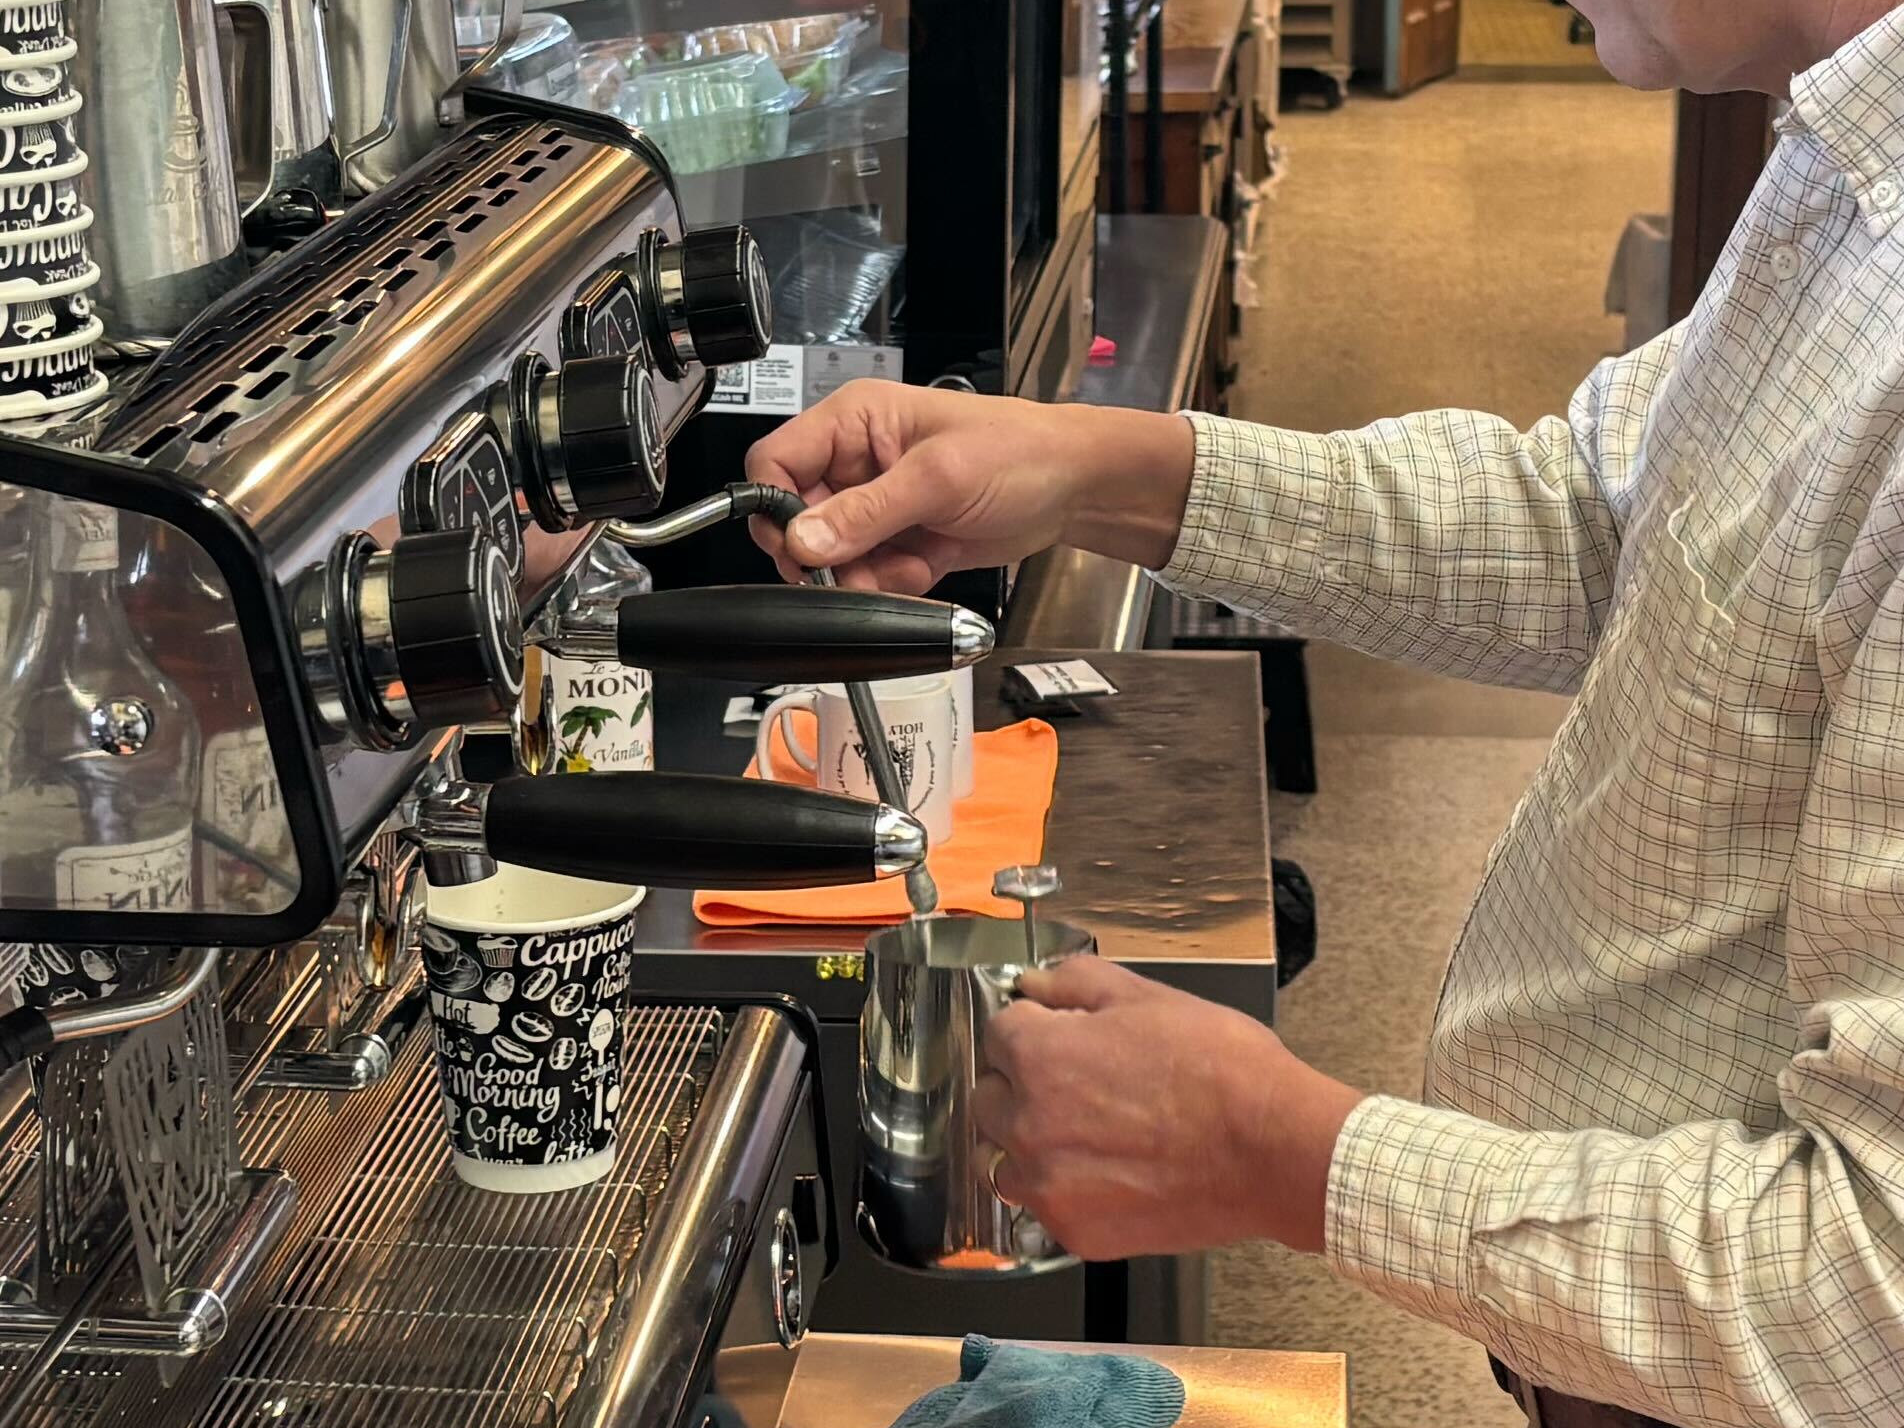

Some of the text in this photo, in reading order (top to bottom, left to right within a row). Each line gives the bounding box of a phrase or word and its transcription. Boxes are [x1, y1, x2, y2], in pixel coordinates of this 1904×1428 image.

[567, 671, 645, 699] MONI
[888, 721, 924, 736] HOLY
[443, 993, 470, 1023] Hot
[476, 1052, 545, 1086] Good
[447, 1064, 561, 1124] Morning
[466, 1106, 543, 1154] Coffee
